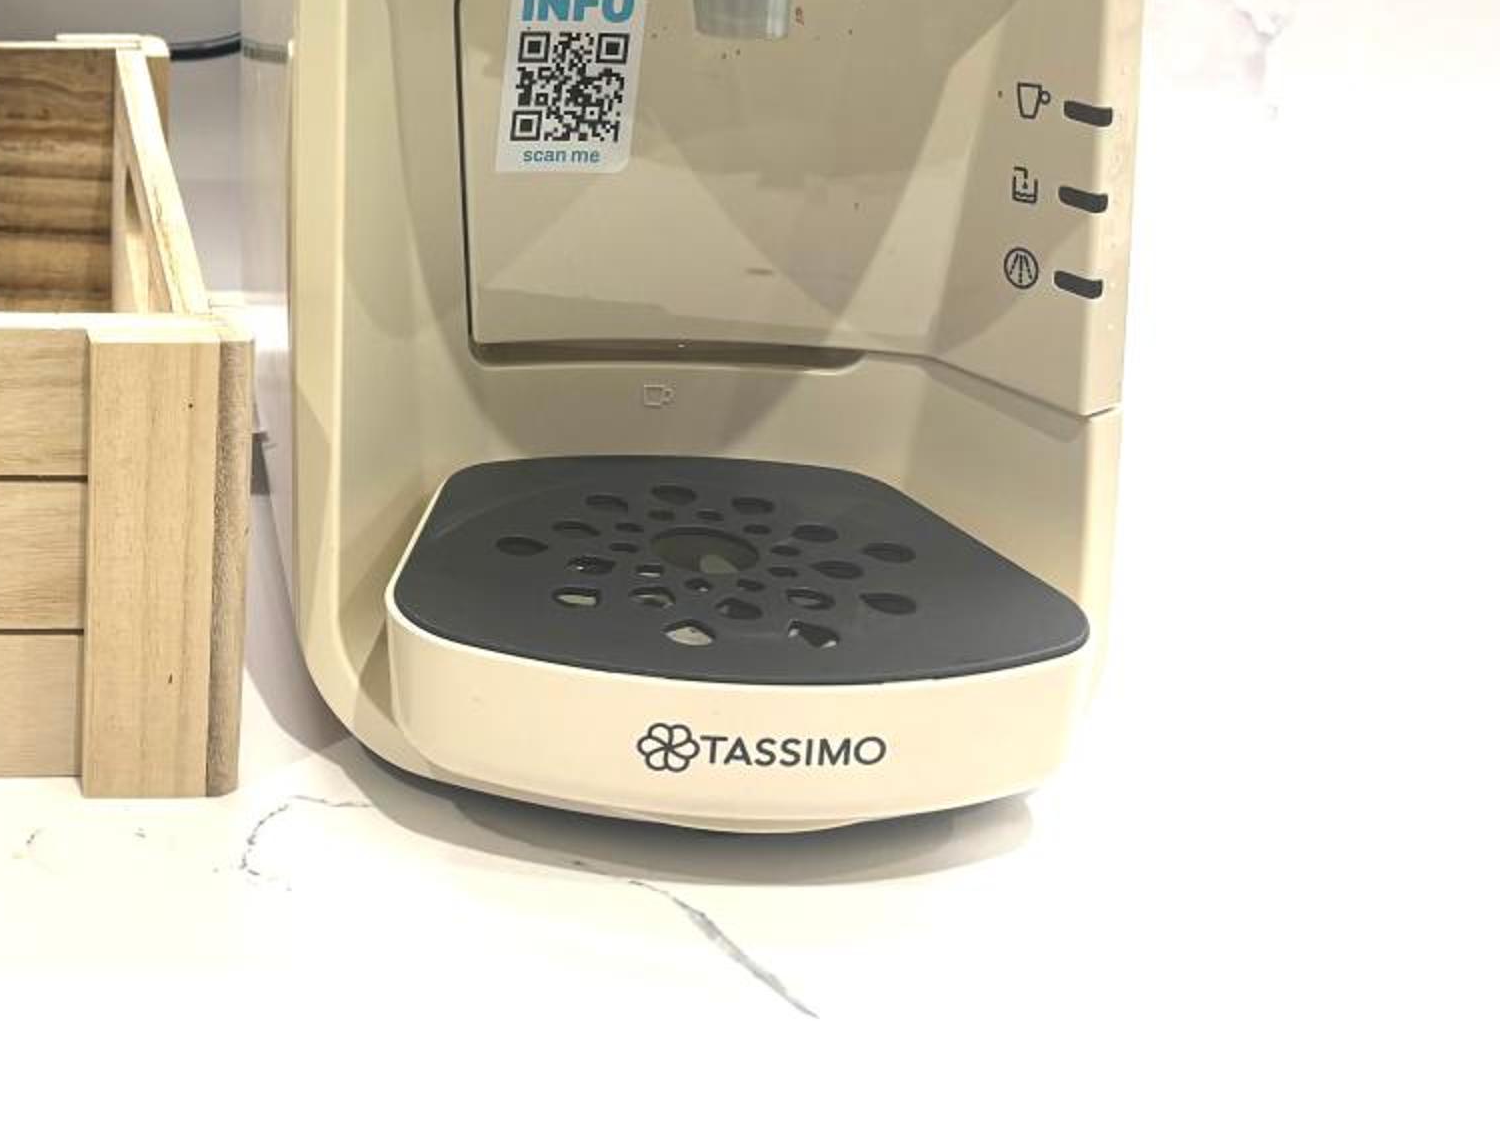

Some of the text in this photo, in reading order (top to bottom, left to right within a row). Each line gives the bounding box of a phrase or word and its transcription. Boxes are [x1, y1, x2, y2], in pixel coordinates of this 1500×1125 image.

[522, 149, 601, 164] scan me
[699, 734, 887, 768] TASSIMO
